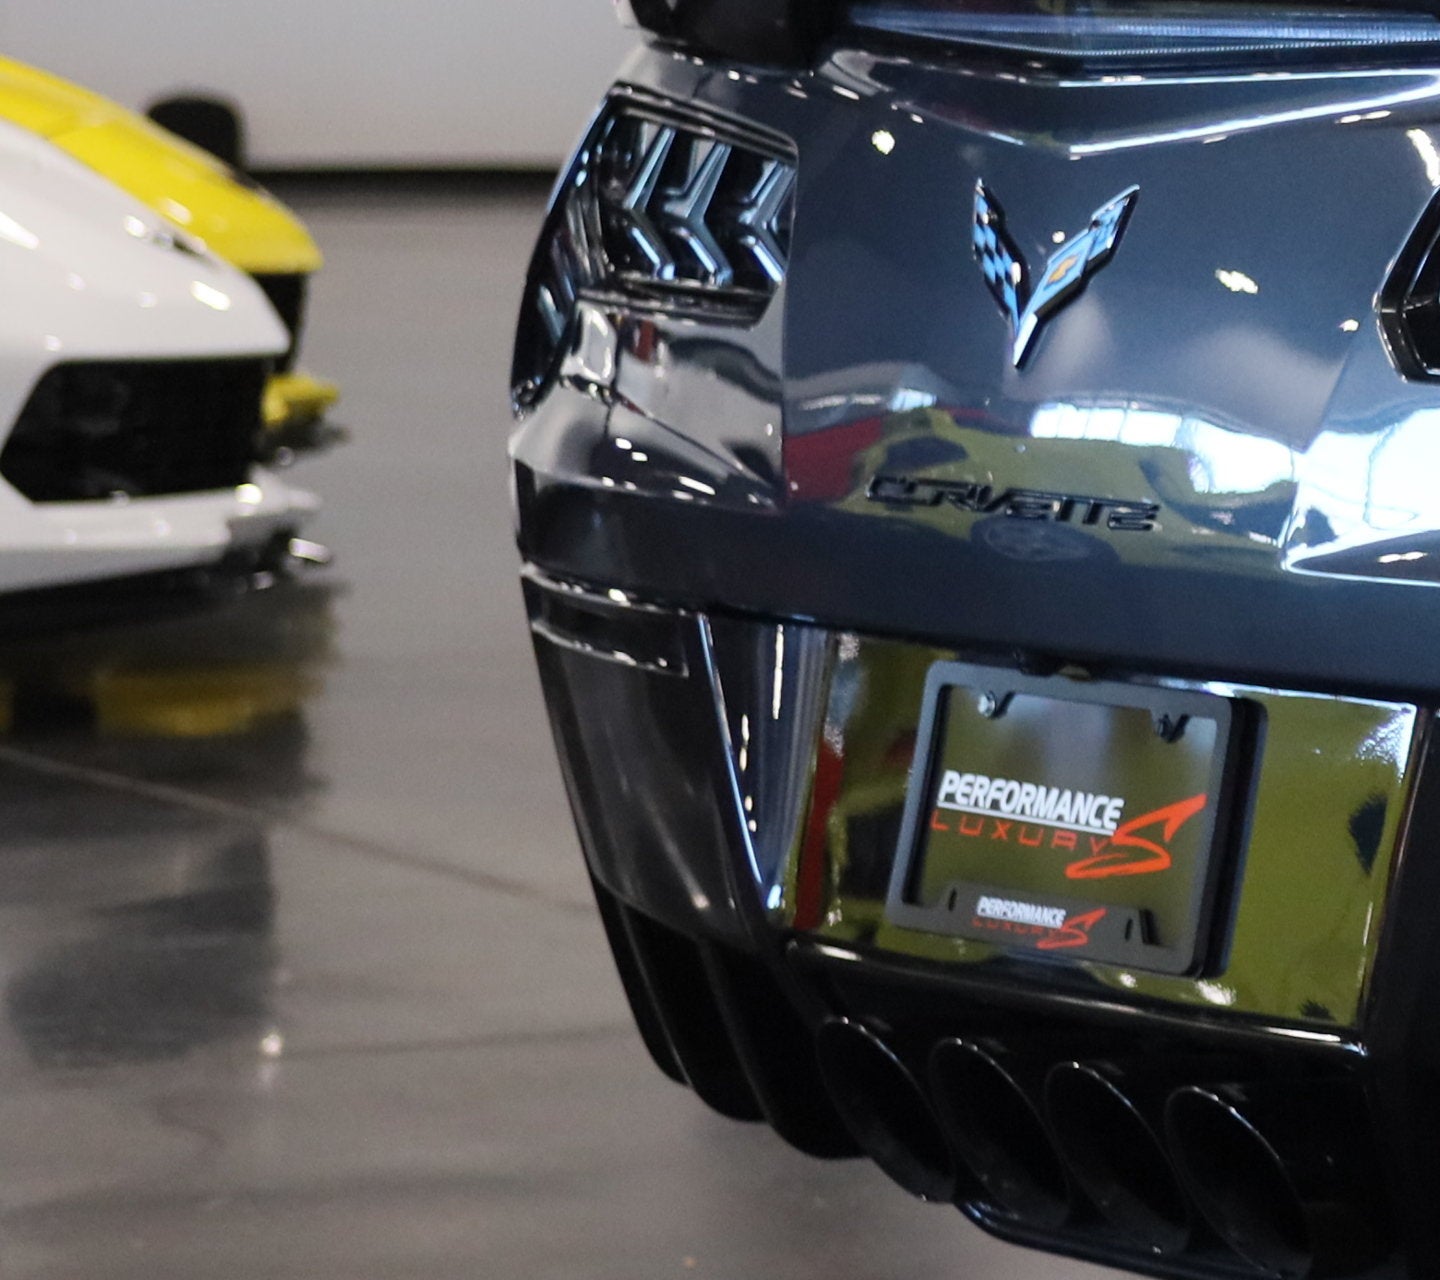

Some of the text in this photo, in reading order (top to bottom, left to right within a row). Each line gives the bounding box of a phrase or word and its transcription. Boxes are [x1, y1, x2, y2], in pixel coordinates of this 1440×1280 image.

[937, 769, 1125, 831] PERFORMANCE
[930, 809, 1112, 856] LUXURY
[976, 895, 1067, 928] PERFORMANCE
